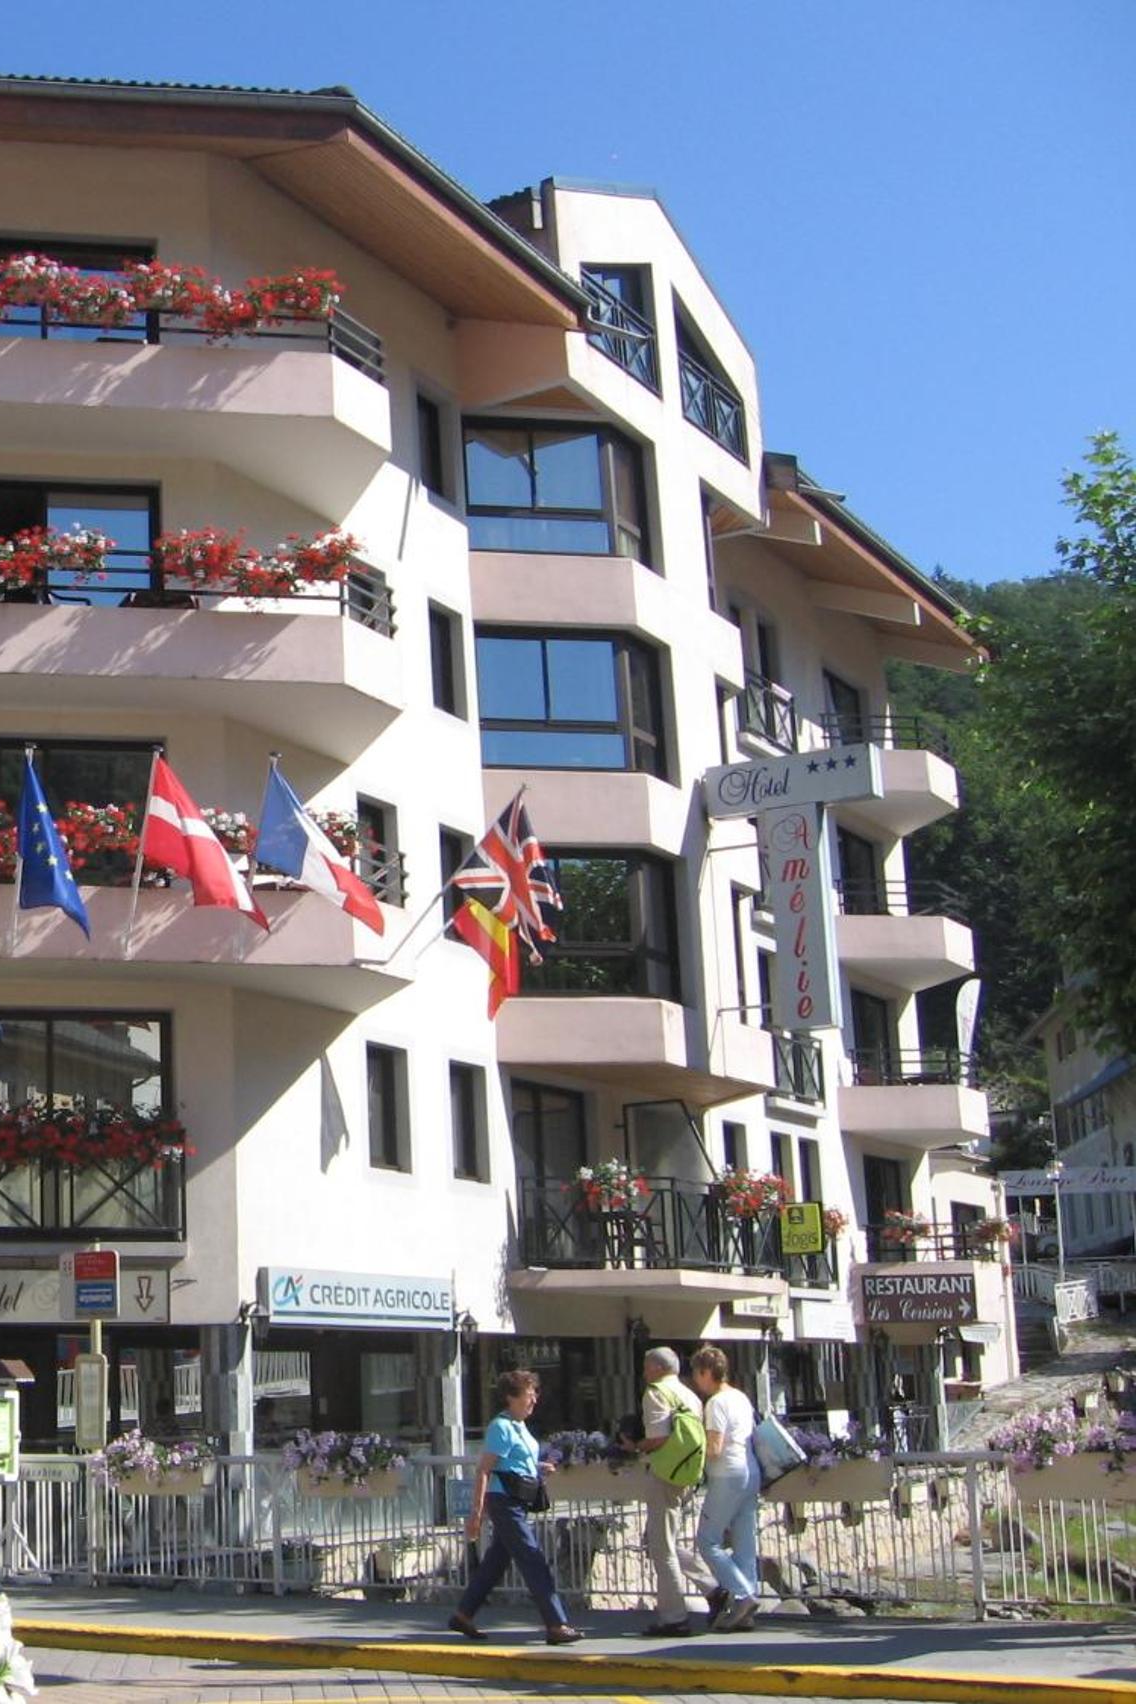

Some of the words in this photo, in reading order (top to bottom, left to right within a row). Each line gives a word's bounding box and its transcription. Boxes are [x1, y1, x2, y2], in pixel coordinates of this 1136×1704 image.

[865, 1276, 972, 1295] RESTAURANT
[309, 1282, 371, 1307] CRÉDIT
[373, 1288, 450, 1311] AGRICOLE
[868, 1300, 889, 1321] Les
